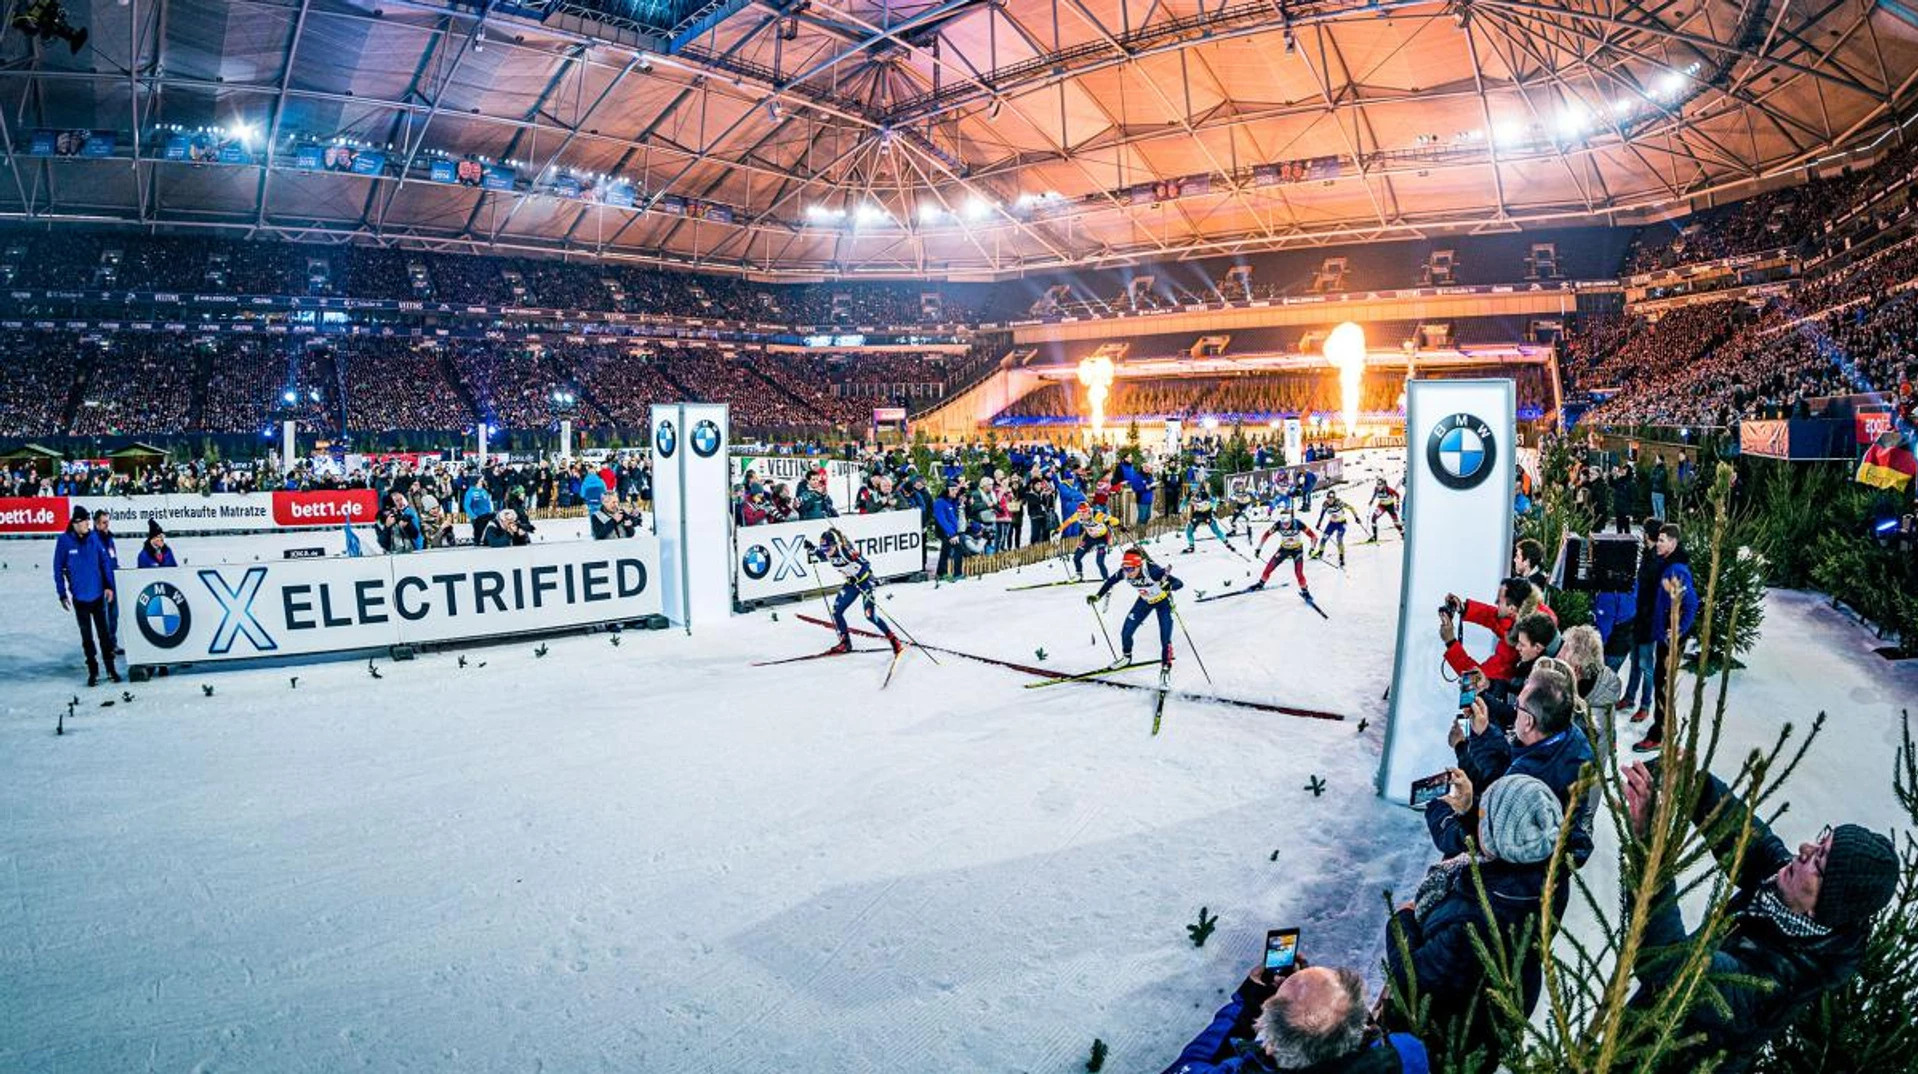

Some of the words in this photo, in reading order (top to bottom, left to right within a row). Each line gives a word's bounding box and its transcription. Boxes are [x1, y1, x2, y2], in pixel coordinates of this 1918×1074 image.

[220, 505, 267, 518] Matratze
[291, 499, 363, 518] bett1.de
[771, 534, 808, 582] X
[197, 566, 278, 654] X
[281, 558, 648, 630] ELECTRIFIED
